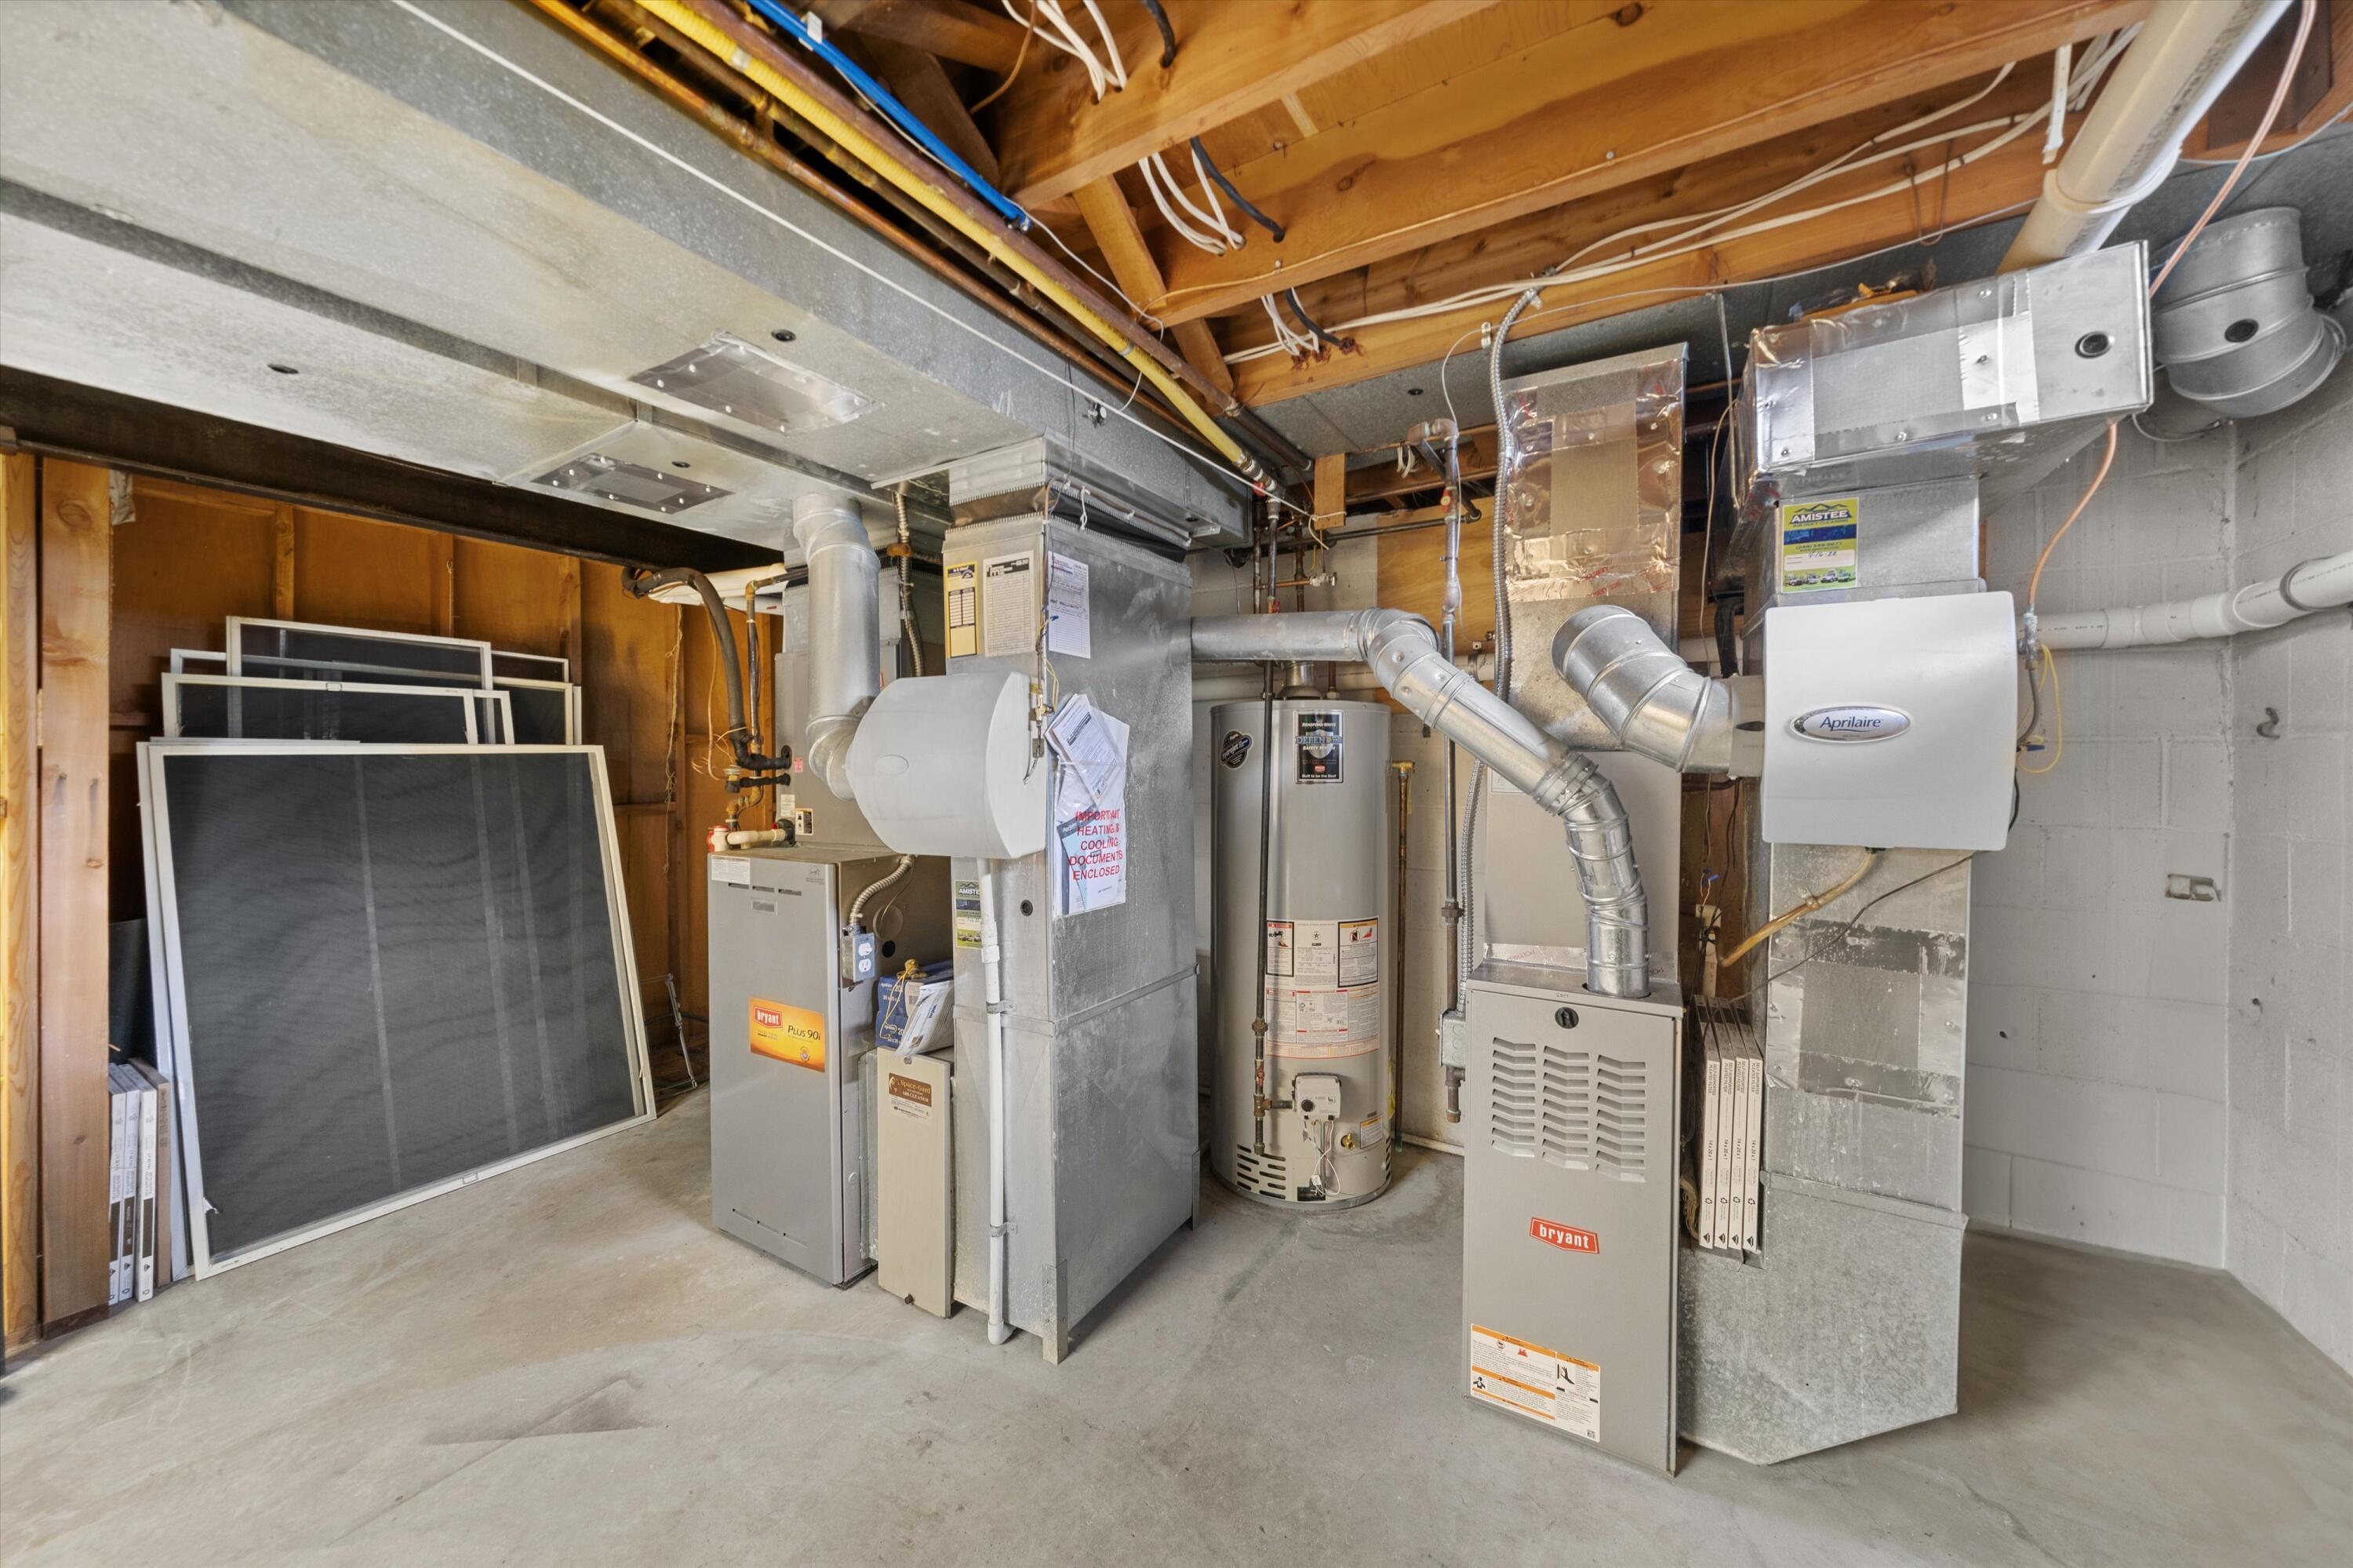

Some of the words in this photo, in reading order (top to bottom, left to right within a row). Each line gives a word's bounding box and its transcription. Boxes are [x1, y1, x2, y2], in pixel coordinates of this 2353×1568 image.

[1791, 510, 1848, 522] AMISTEE
[1820, 716, 1882, 731] Aprilaire
[1075, 809, 1120, 821] IMPORTANT
[1077, 824, 1115, 836] HEATING
[1081, 838, 1118, 850] COOLING
[1068, 850, 1123, 866] DOCUMENTS
[1073, 865, 1120, 880] ENCLOSED
[757, 1010, 780, 1024] bryant
[807, 1029, 821, 1041] 90i
[909, 1093, 929, 1103] CLEANER
[1539, 1224, 1589, 1249] bryant
